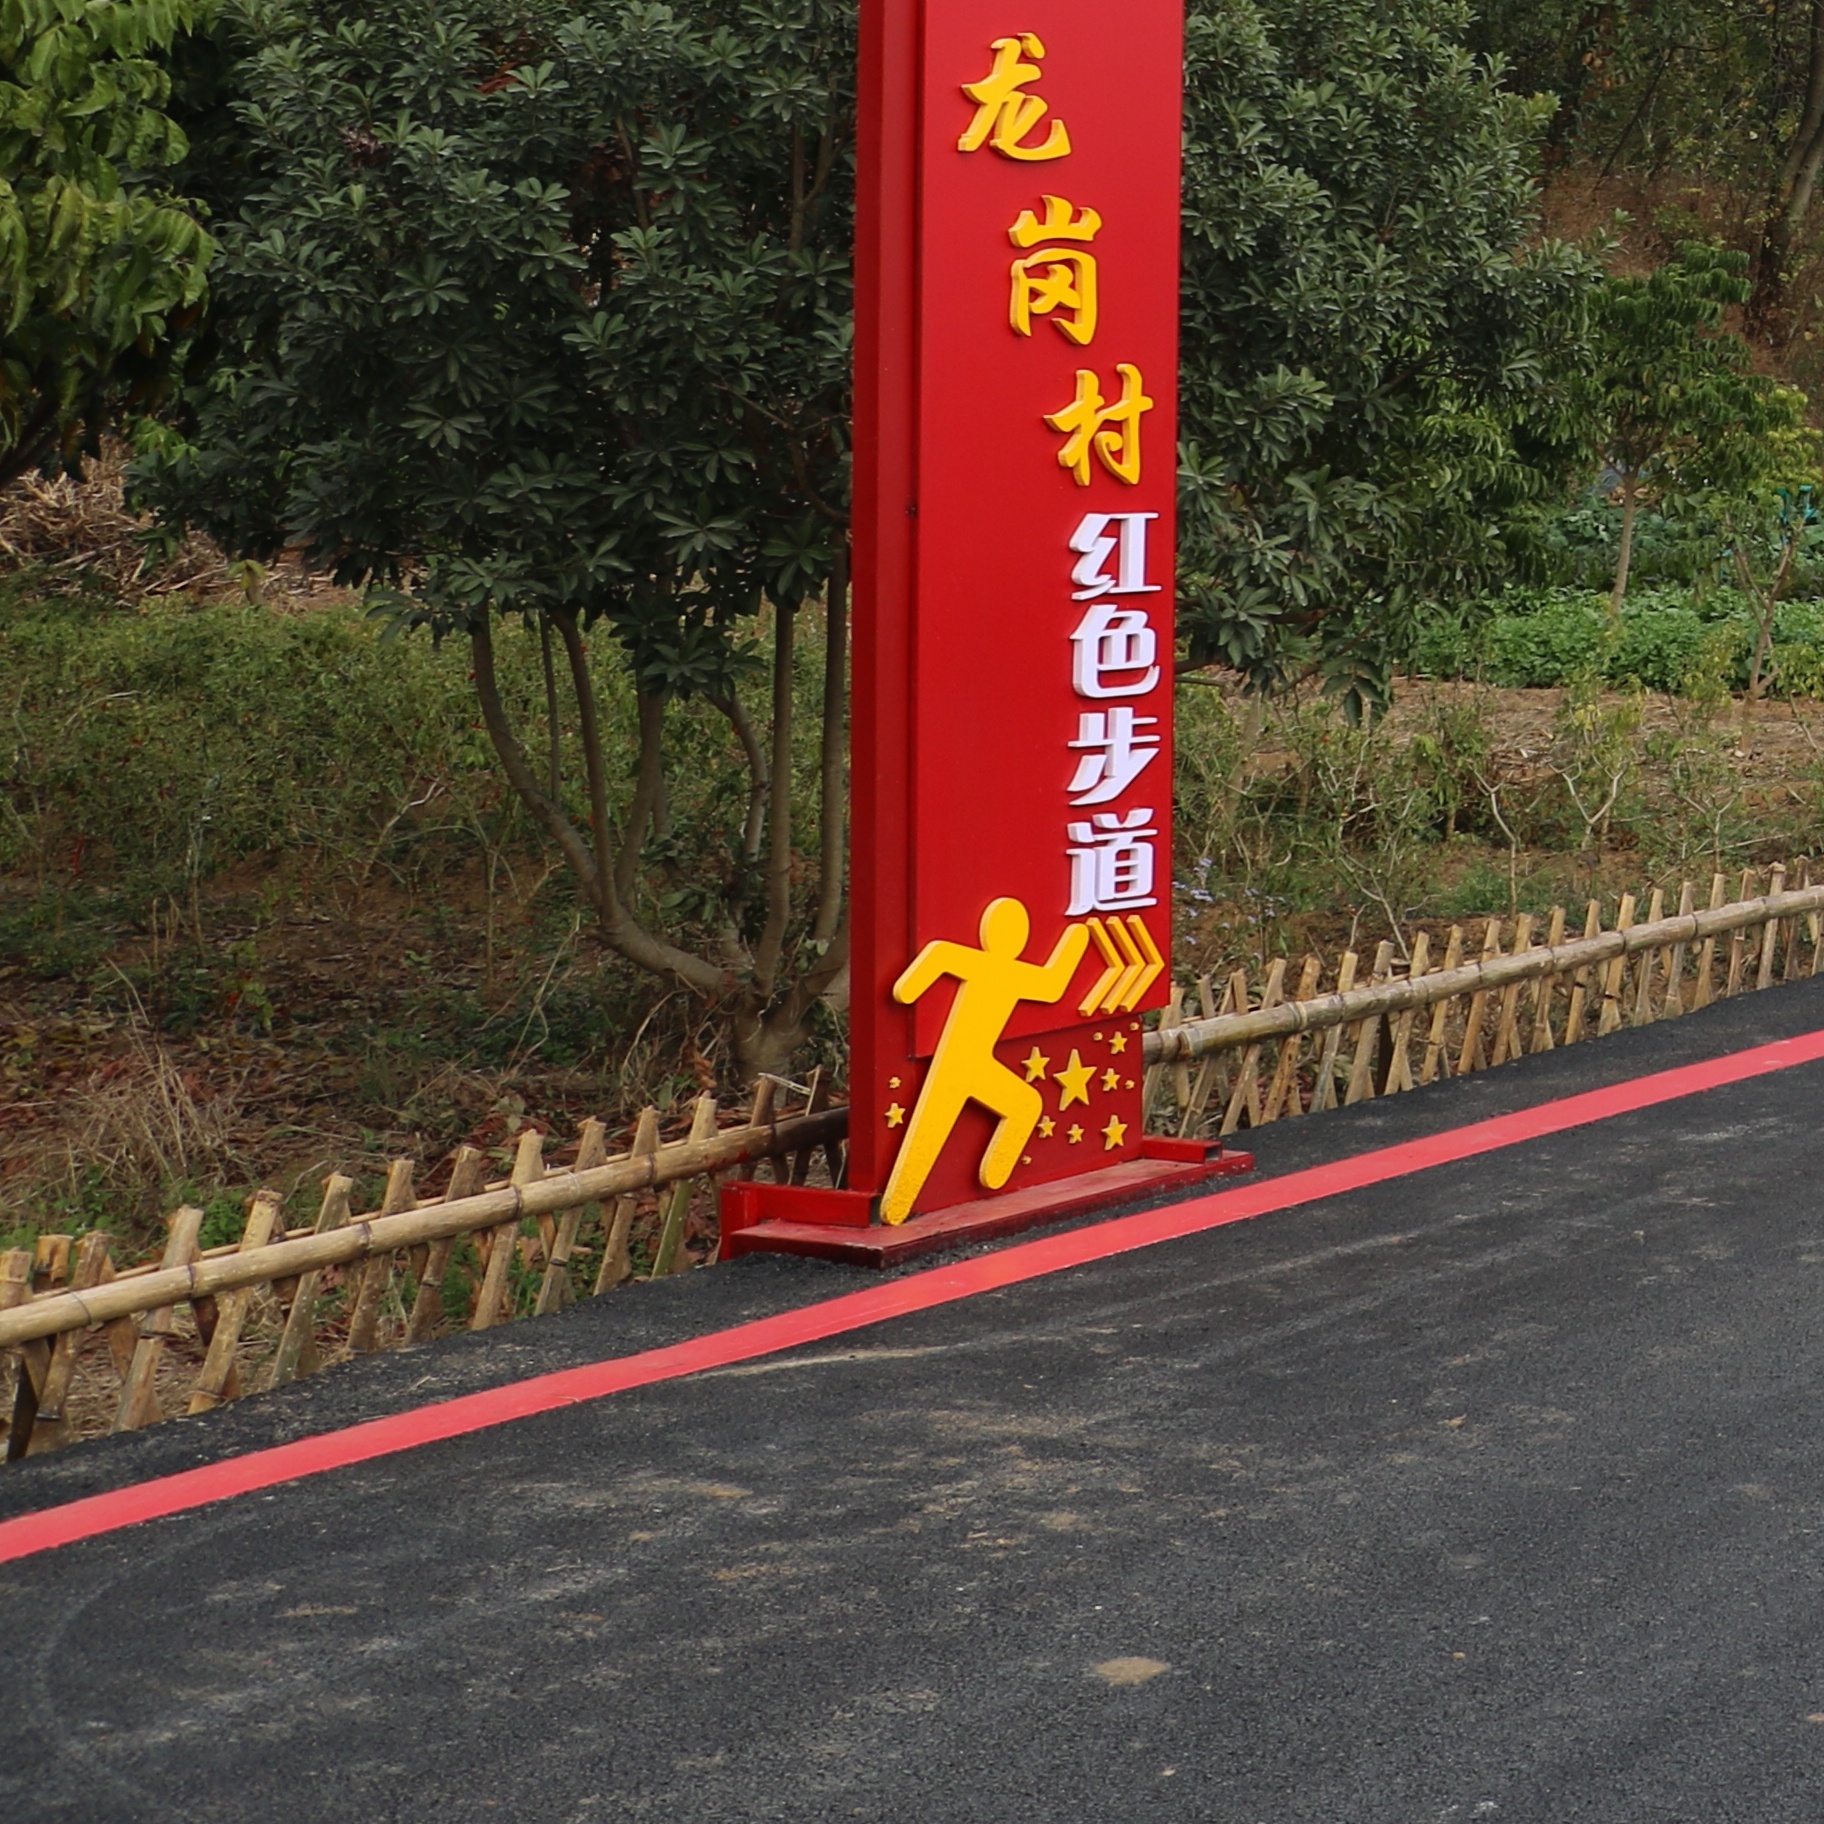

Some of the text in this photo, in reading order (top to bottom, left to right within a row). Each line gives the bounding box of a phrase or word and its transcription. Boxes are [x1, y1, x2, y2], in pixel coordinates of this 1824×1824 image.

[957, 31, 1155, 487] 龙岗村
[1063, 511, 1163, 917] 红色步道
